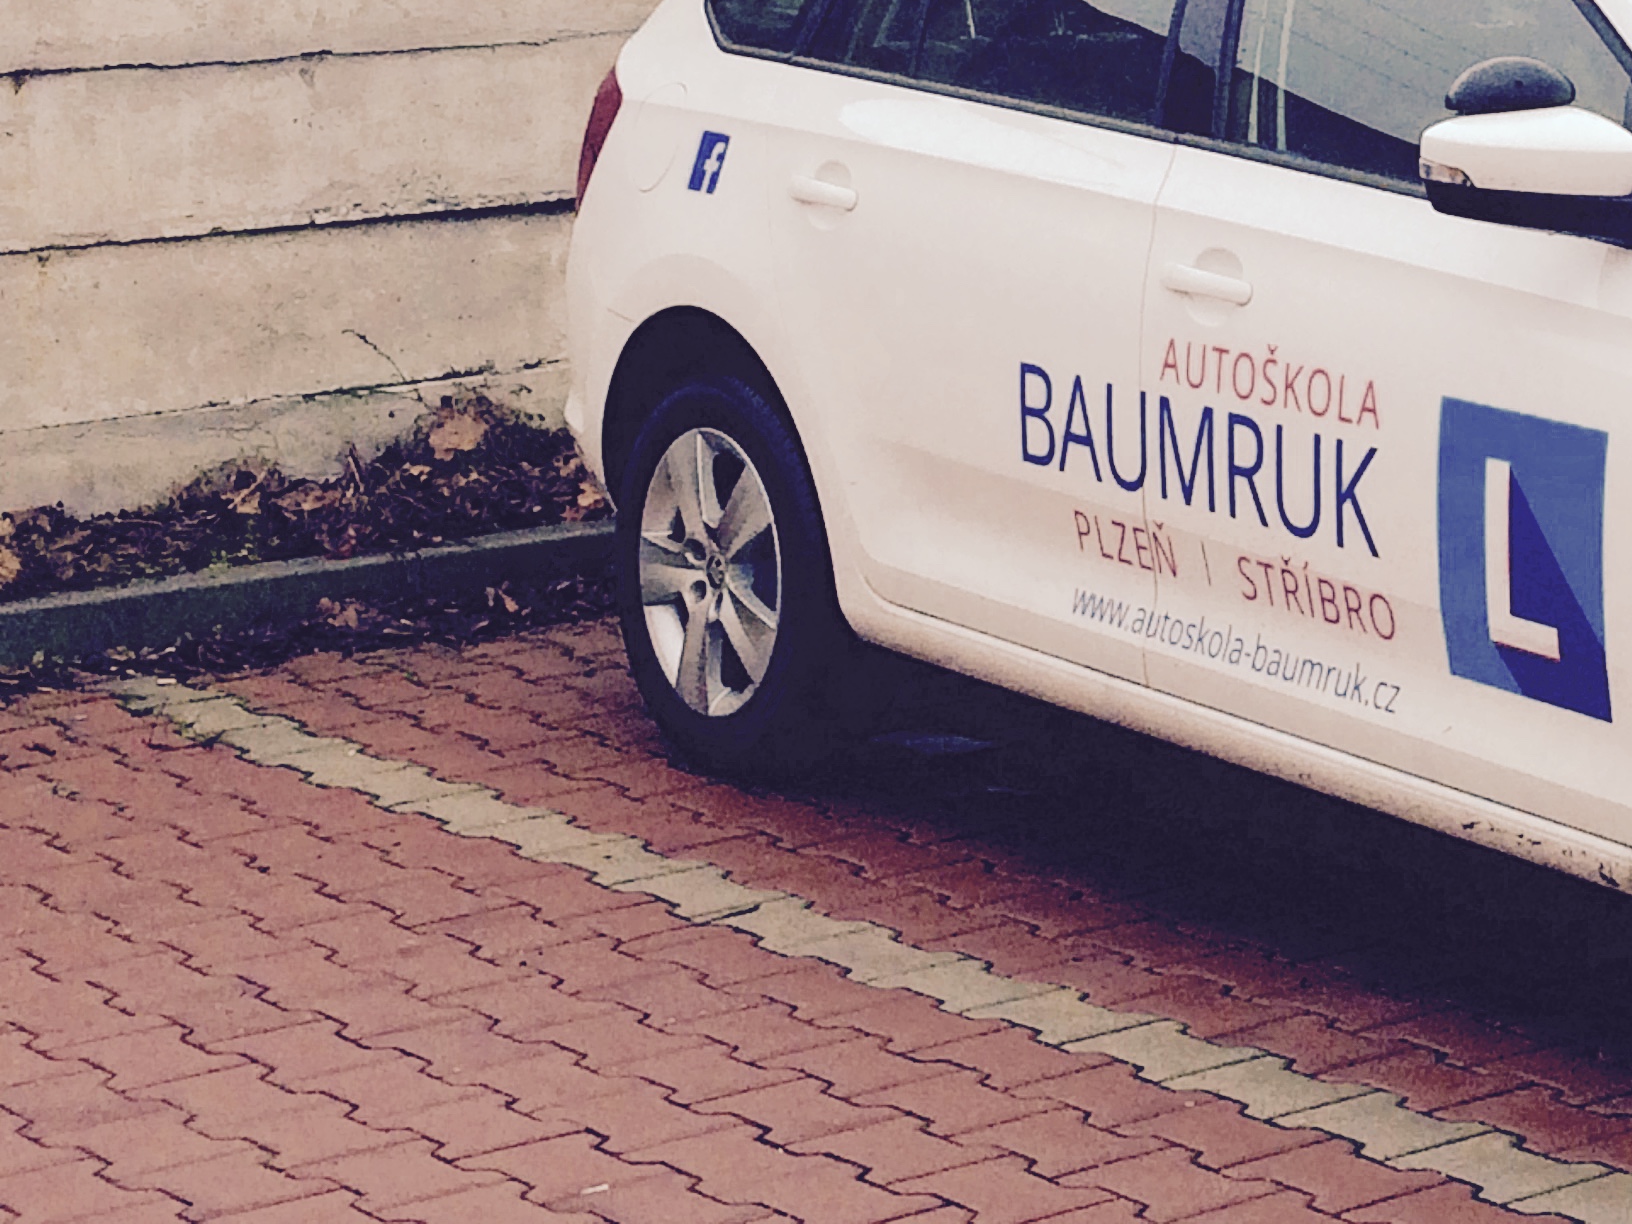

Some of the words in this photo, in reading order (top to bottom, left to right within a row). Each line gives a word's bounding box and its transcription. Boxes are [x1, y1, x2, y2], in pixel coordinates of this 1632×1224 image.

[1160, 338, 1380, 430] AUTOŠKOLA
[1020, 362, 1380, 558] BAUMRUK
[1074, 510, 1177, 577] PLZEŇ
[1238, 556, 1396, 640] STŘÍBRO
[1484, 457, 1561, 663] L
[1072, 587, 1401, 714] www.autoskola-baumruk.cz
